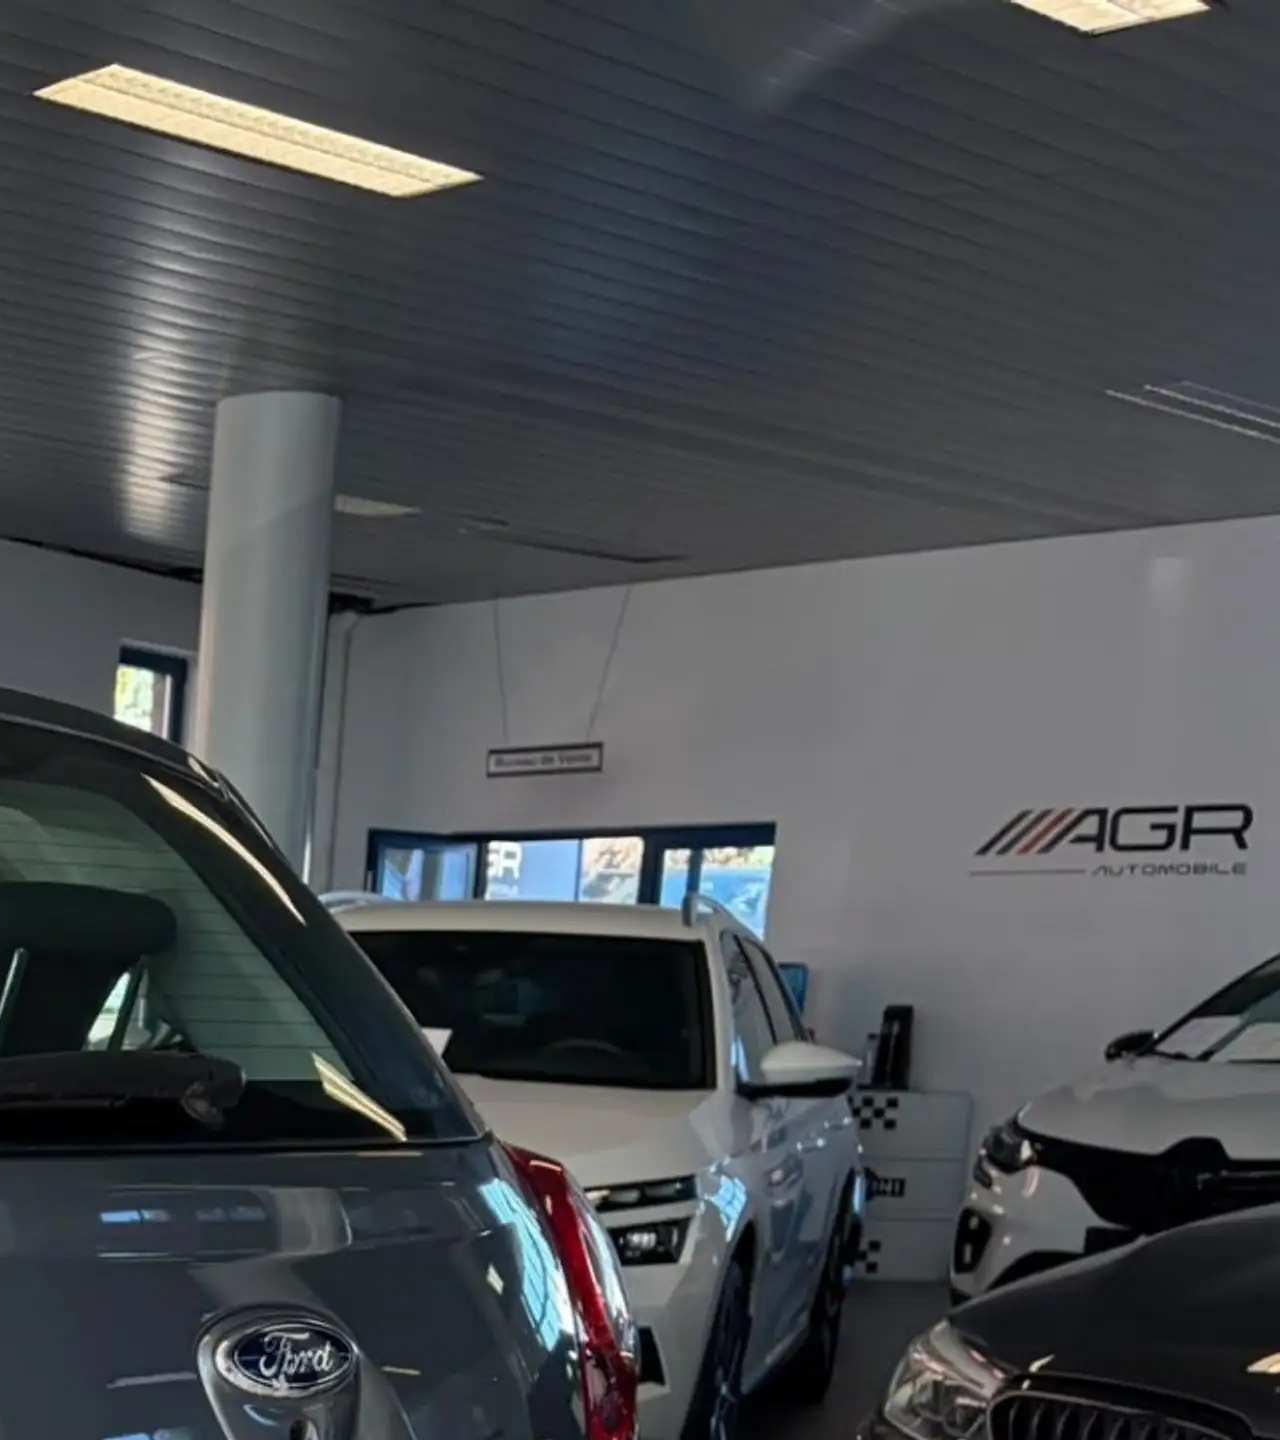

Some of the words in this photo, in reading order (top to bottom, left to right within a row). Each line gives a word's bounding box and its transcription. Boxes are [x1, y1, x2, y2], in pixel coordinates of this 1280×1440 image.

[1036, 804, 1253, 853] AGR
[1091, 861, 1249, 877] AUTOMOBILE
[259, 1331, 333, 1377] Ford
